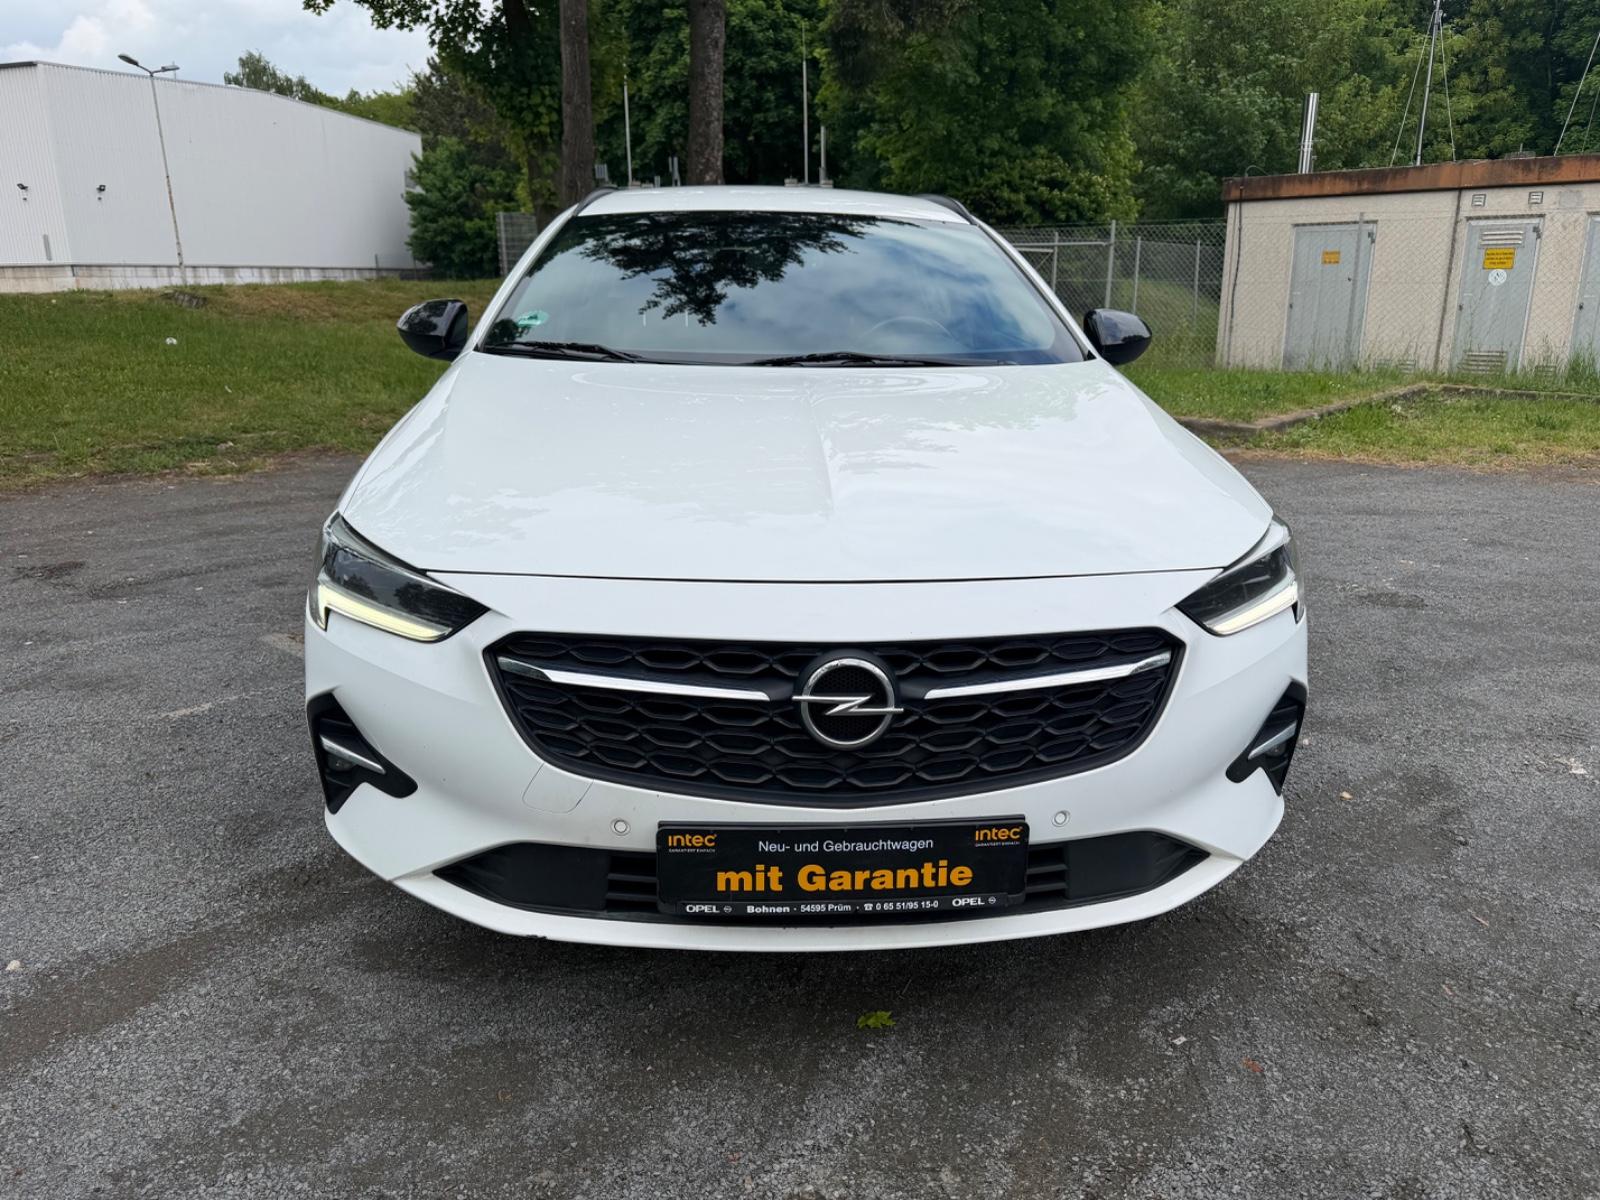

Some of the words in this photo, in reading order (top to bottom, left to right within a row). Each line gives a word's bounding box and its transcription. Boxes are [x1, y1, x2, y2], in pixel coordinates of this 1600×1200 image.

[758, 841, 790, 852] Neu-
[795, 841, 819, 852] und
[823, 839, 934, 853] Gebrauchtwagen
[716, 864, 783, 892] mit
[797, 860, 974, 892] Garantie
[952, 897, 985, 907] OPEL
[685, 904, 720, 913] OPEL
[746, 905, 790, 914] Bohnen
[800, 903, 826, 912] 54595
[828, 903, 851, 912] Prüm
